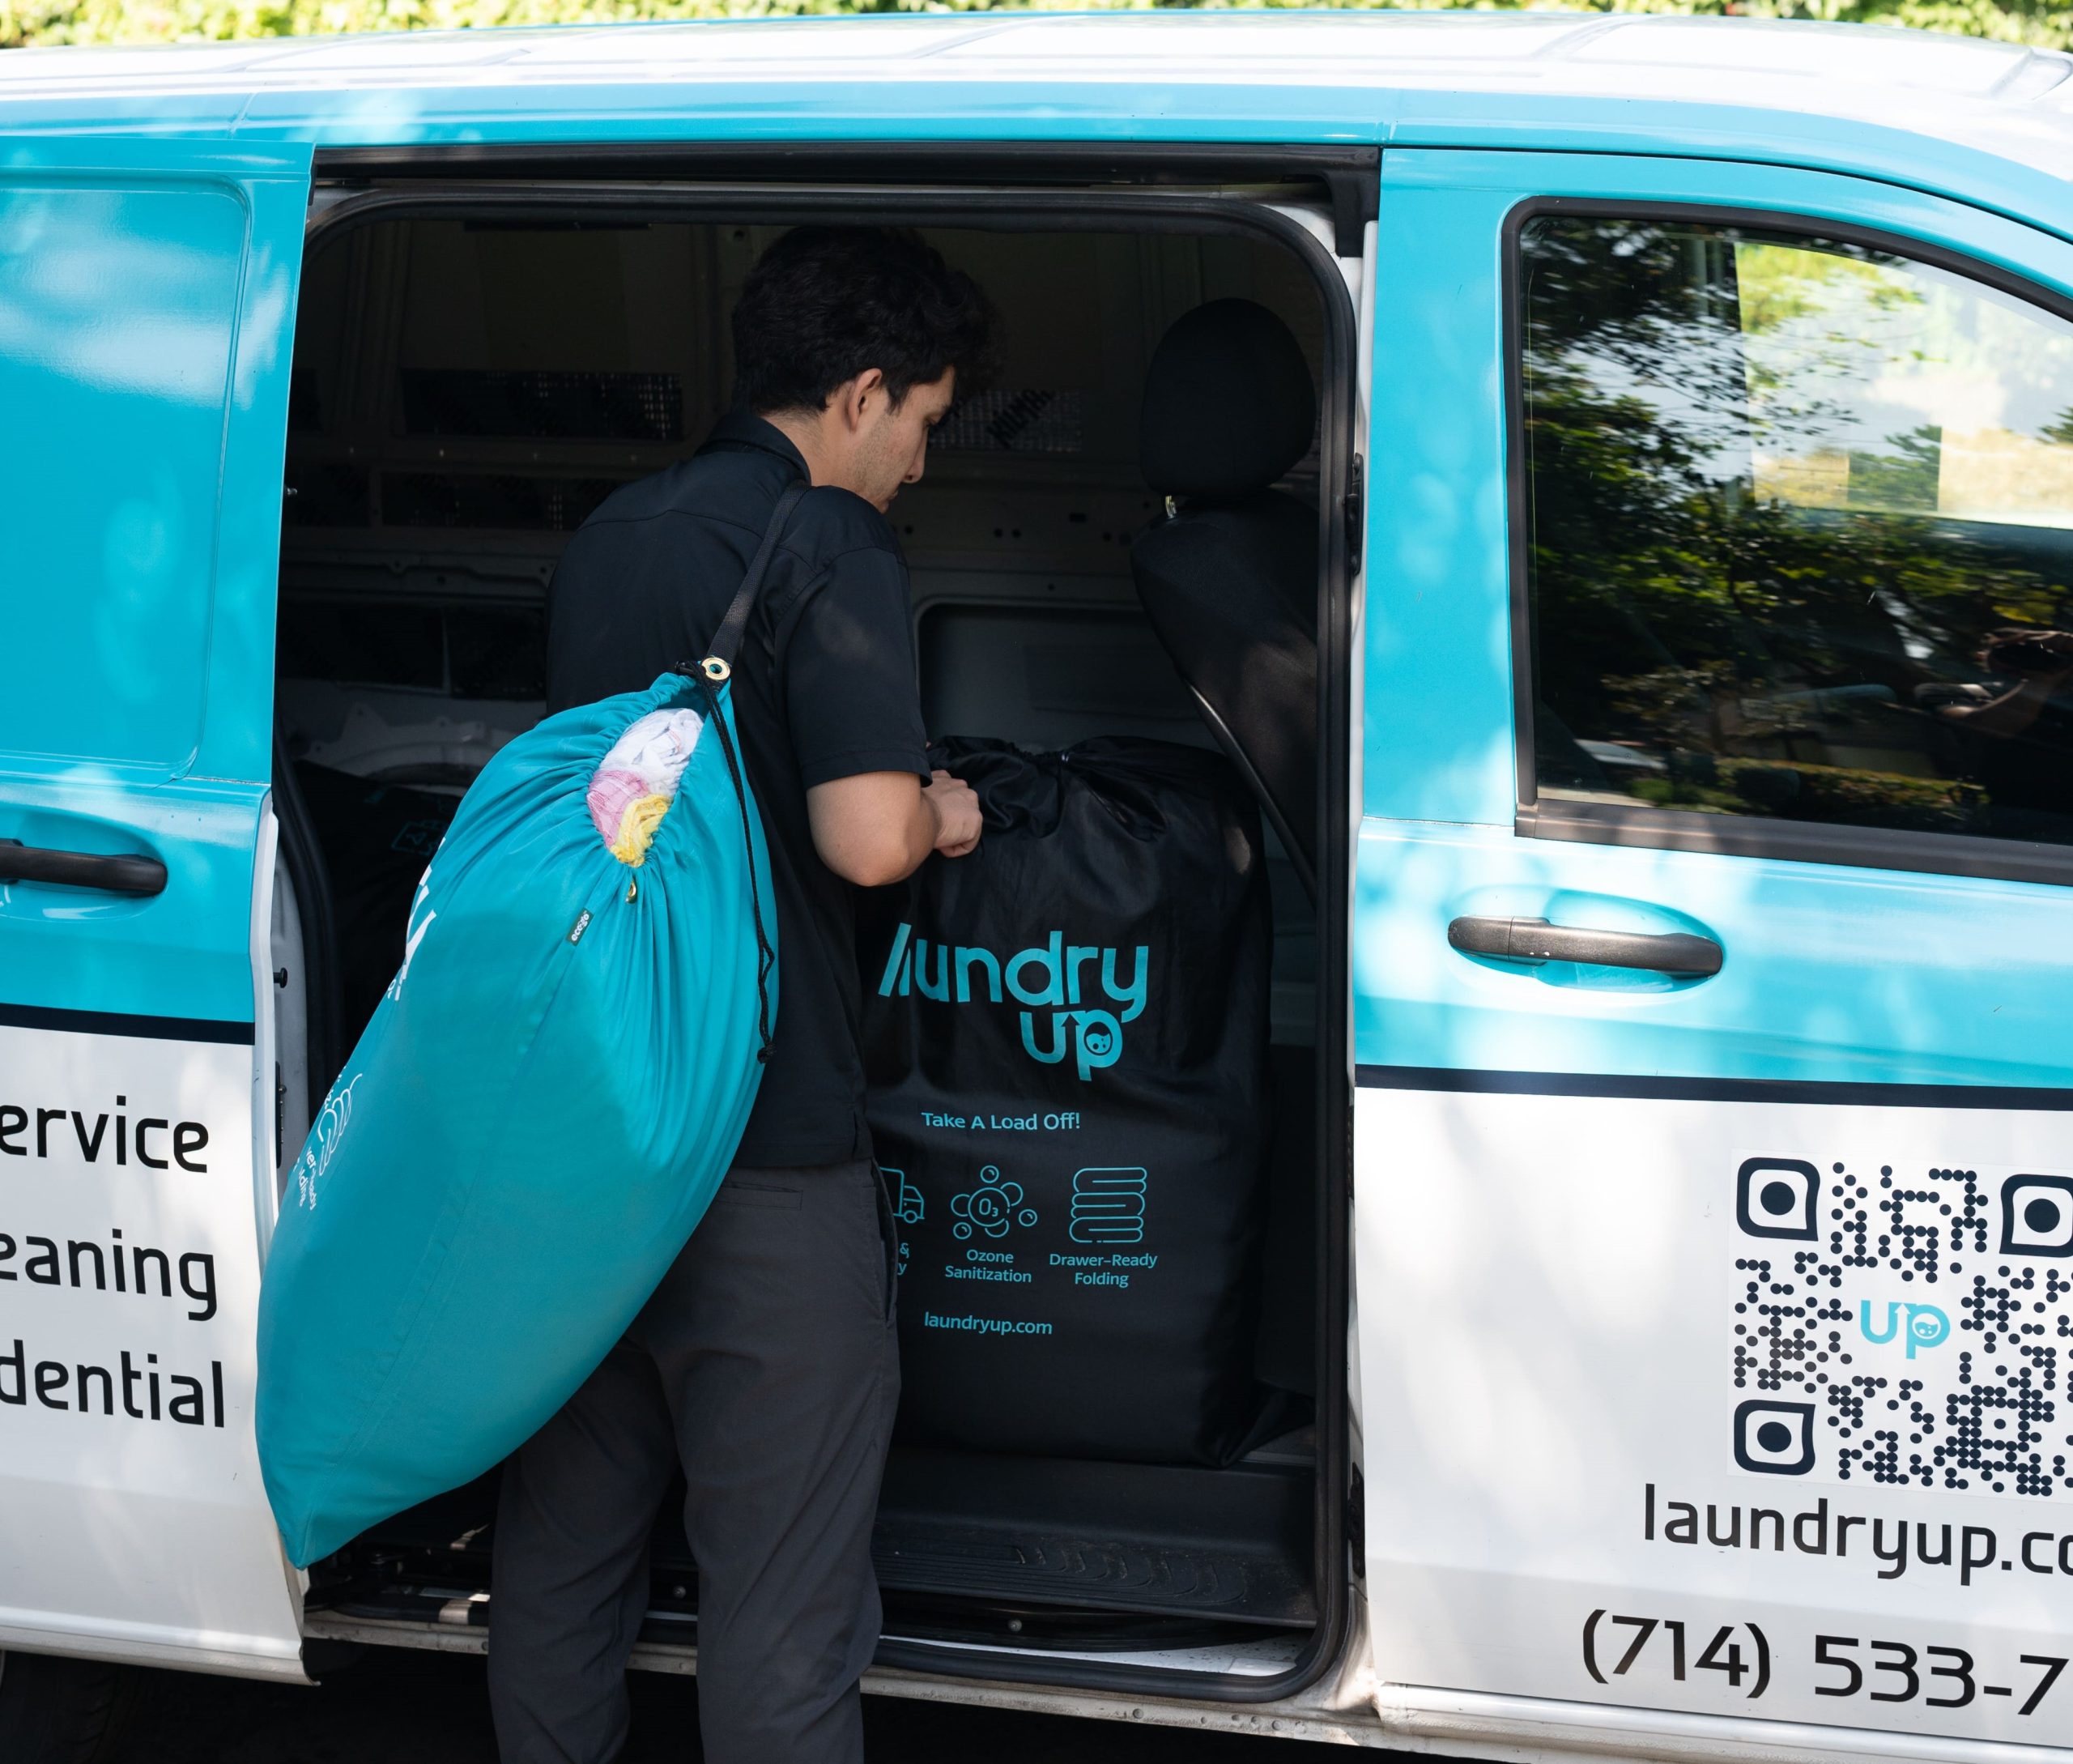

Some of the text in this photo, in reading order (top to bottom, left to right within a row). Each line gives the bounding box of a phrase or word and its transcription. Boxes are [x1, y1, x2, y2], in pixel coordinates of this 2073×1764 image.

[878, 922, 1149, 1024] lundry
[1019, 1009, 1123, 1082] up
[0, 1095, 209, 1174] ervice
[921, 1112, 1081, 1131] Take A Load Off!
[944, 1265, 1032, 1284] Sanitization
[966, 1249, 1014, 1263] Ozone
[1049, 1252, 1158, 1269] Drawer-Ready
[1074, 1272, 1129, 1289] Folding
[924, 1311, 1053, 1336] laundryup.com
[1860, 1299, 1951, 1360] up
[0, 1339, 225, 1429] dential
[1582, 1608, 2070, 1716] (714) 533-7
